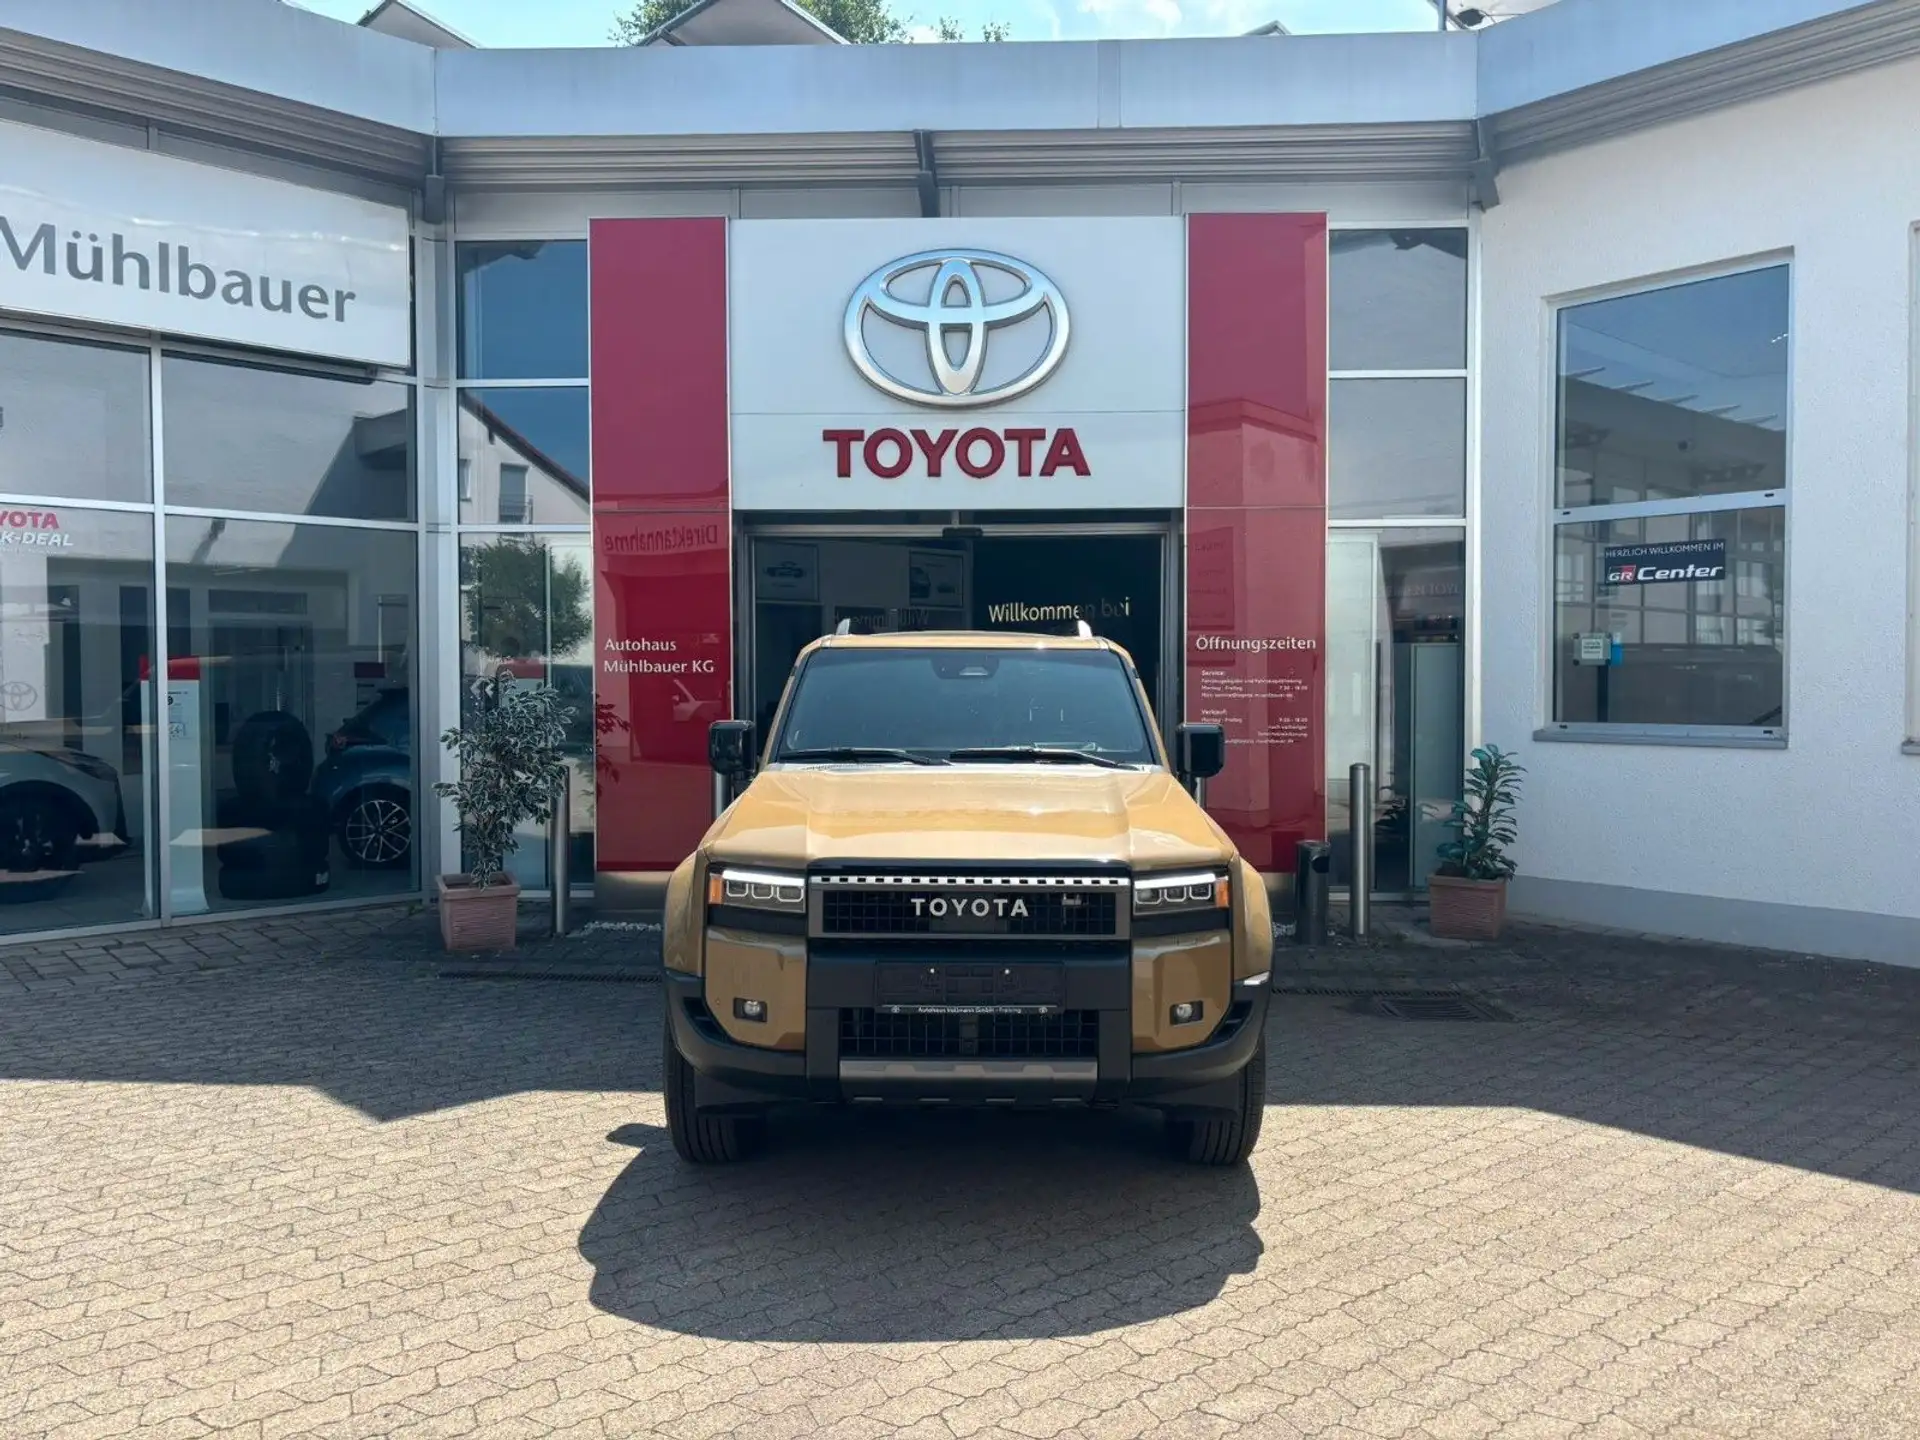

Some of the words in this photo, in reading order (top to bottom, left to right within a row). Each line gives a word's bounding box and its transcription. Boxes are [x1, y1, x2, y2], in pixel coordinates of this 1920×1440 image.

[0, 214, 356, 322] Mühlbauer
[822, 427, 1091, 479] TOYOTA
[1605, 547, 1647, 559] HERZLICH
[1648, 542, 1711, 556] WILLKOMMEN
[1713, 541, 1724, 551] IM
[1637, 563, 1723, 581] Center
[604, 637, 677, 652] Autohaus
[1196, 635, 1316, 653] Öffnungszeiten
[603, 659, 687, 674] Mühlbauer
[692, 659, 714, 674] KG
[911, 898, 1029, 917] TOYOTA
